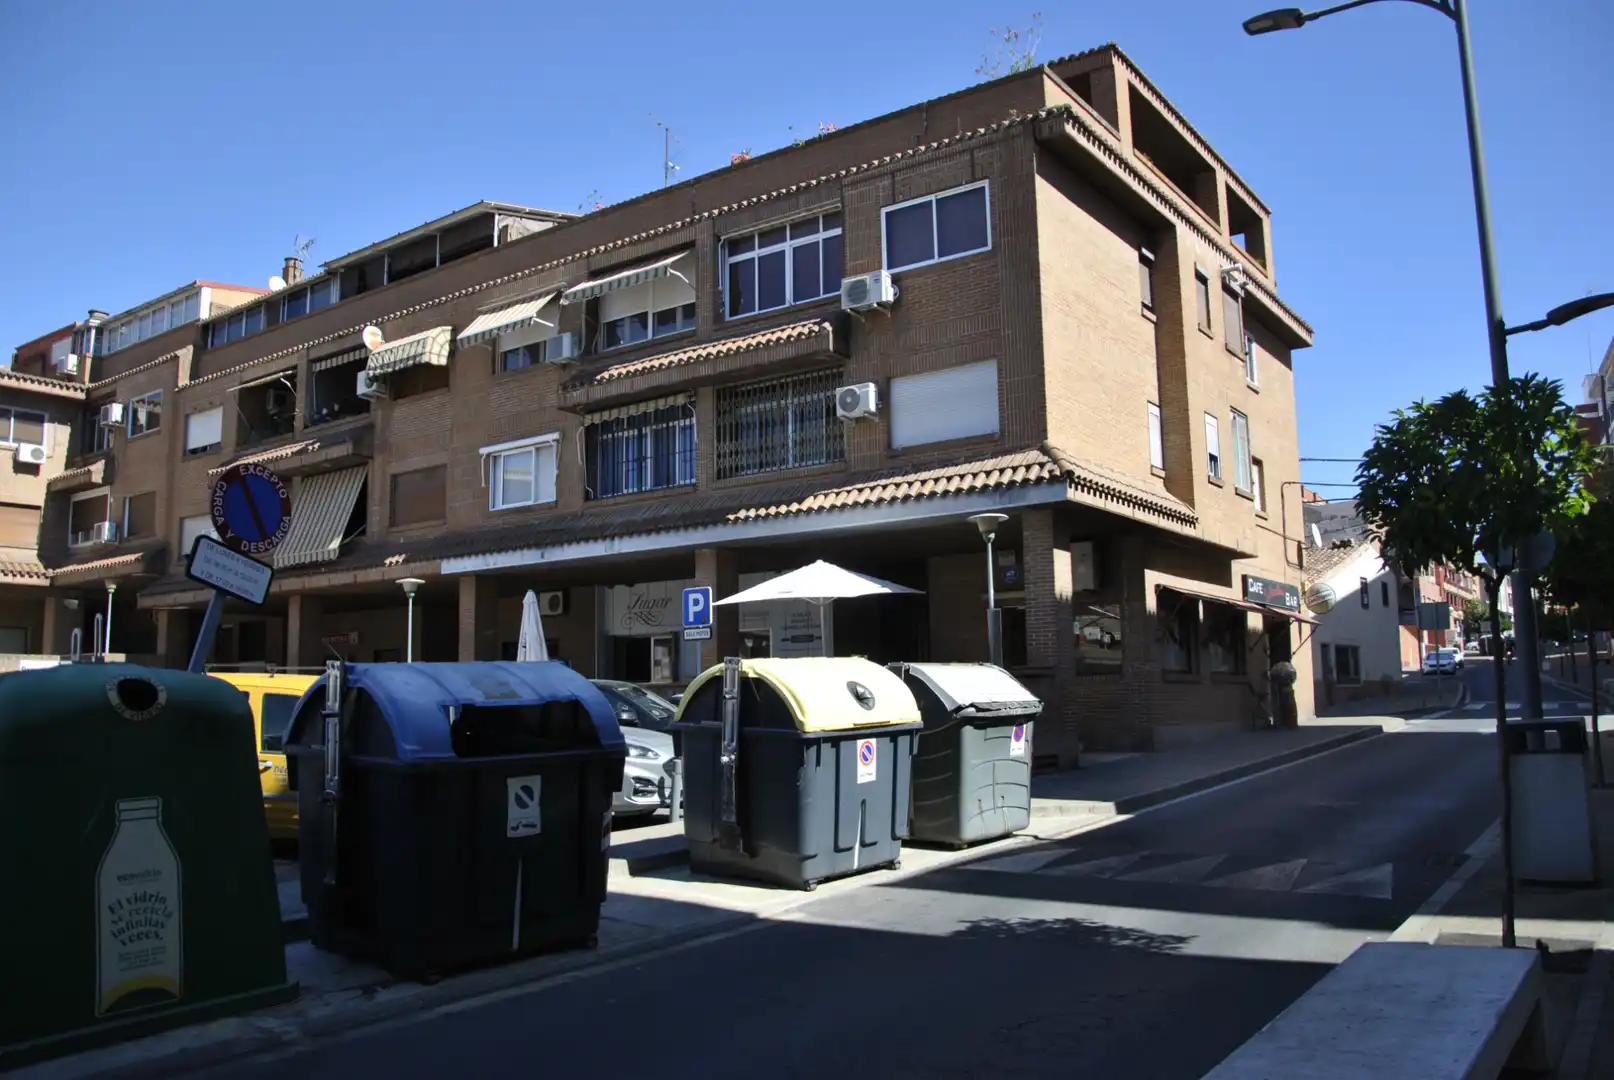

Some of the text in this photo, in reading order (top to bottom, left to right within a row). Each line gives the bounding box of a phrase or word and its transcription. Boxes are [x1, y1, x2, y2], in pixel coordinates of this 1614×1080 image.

[239, 464, 287, 499] EXCEPTO
[213, 481, 291, 552] CARGA Y DESCARGA
[688, 593, 704, 622] P
[1285, 592, 1298, 607] BAR
[108, 890, 168, 915] El vidrio
